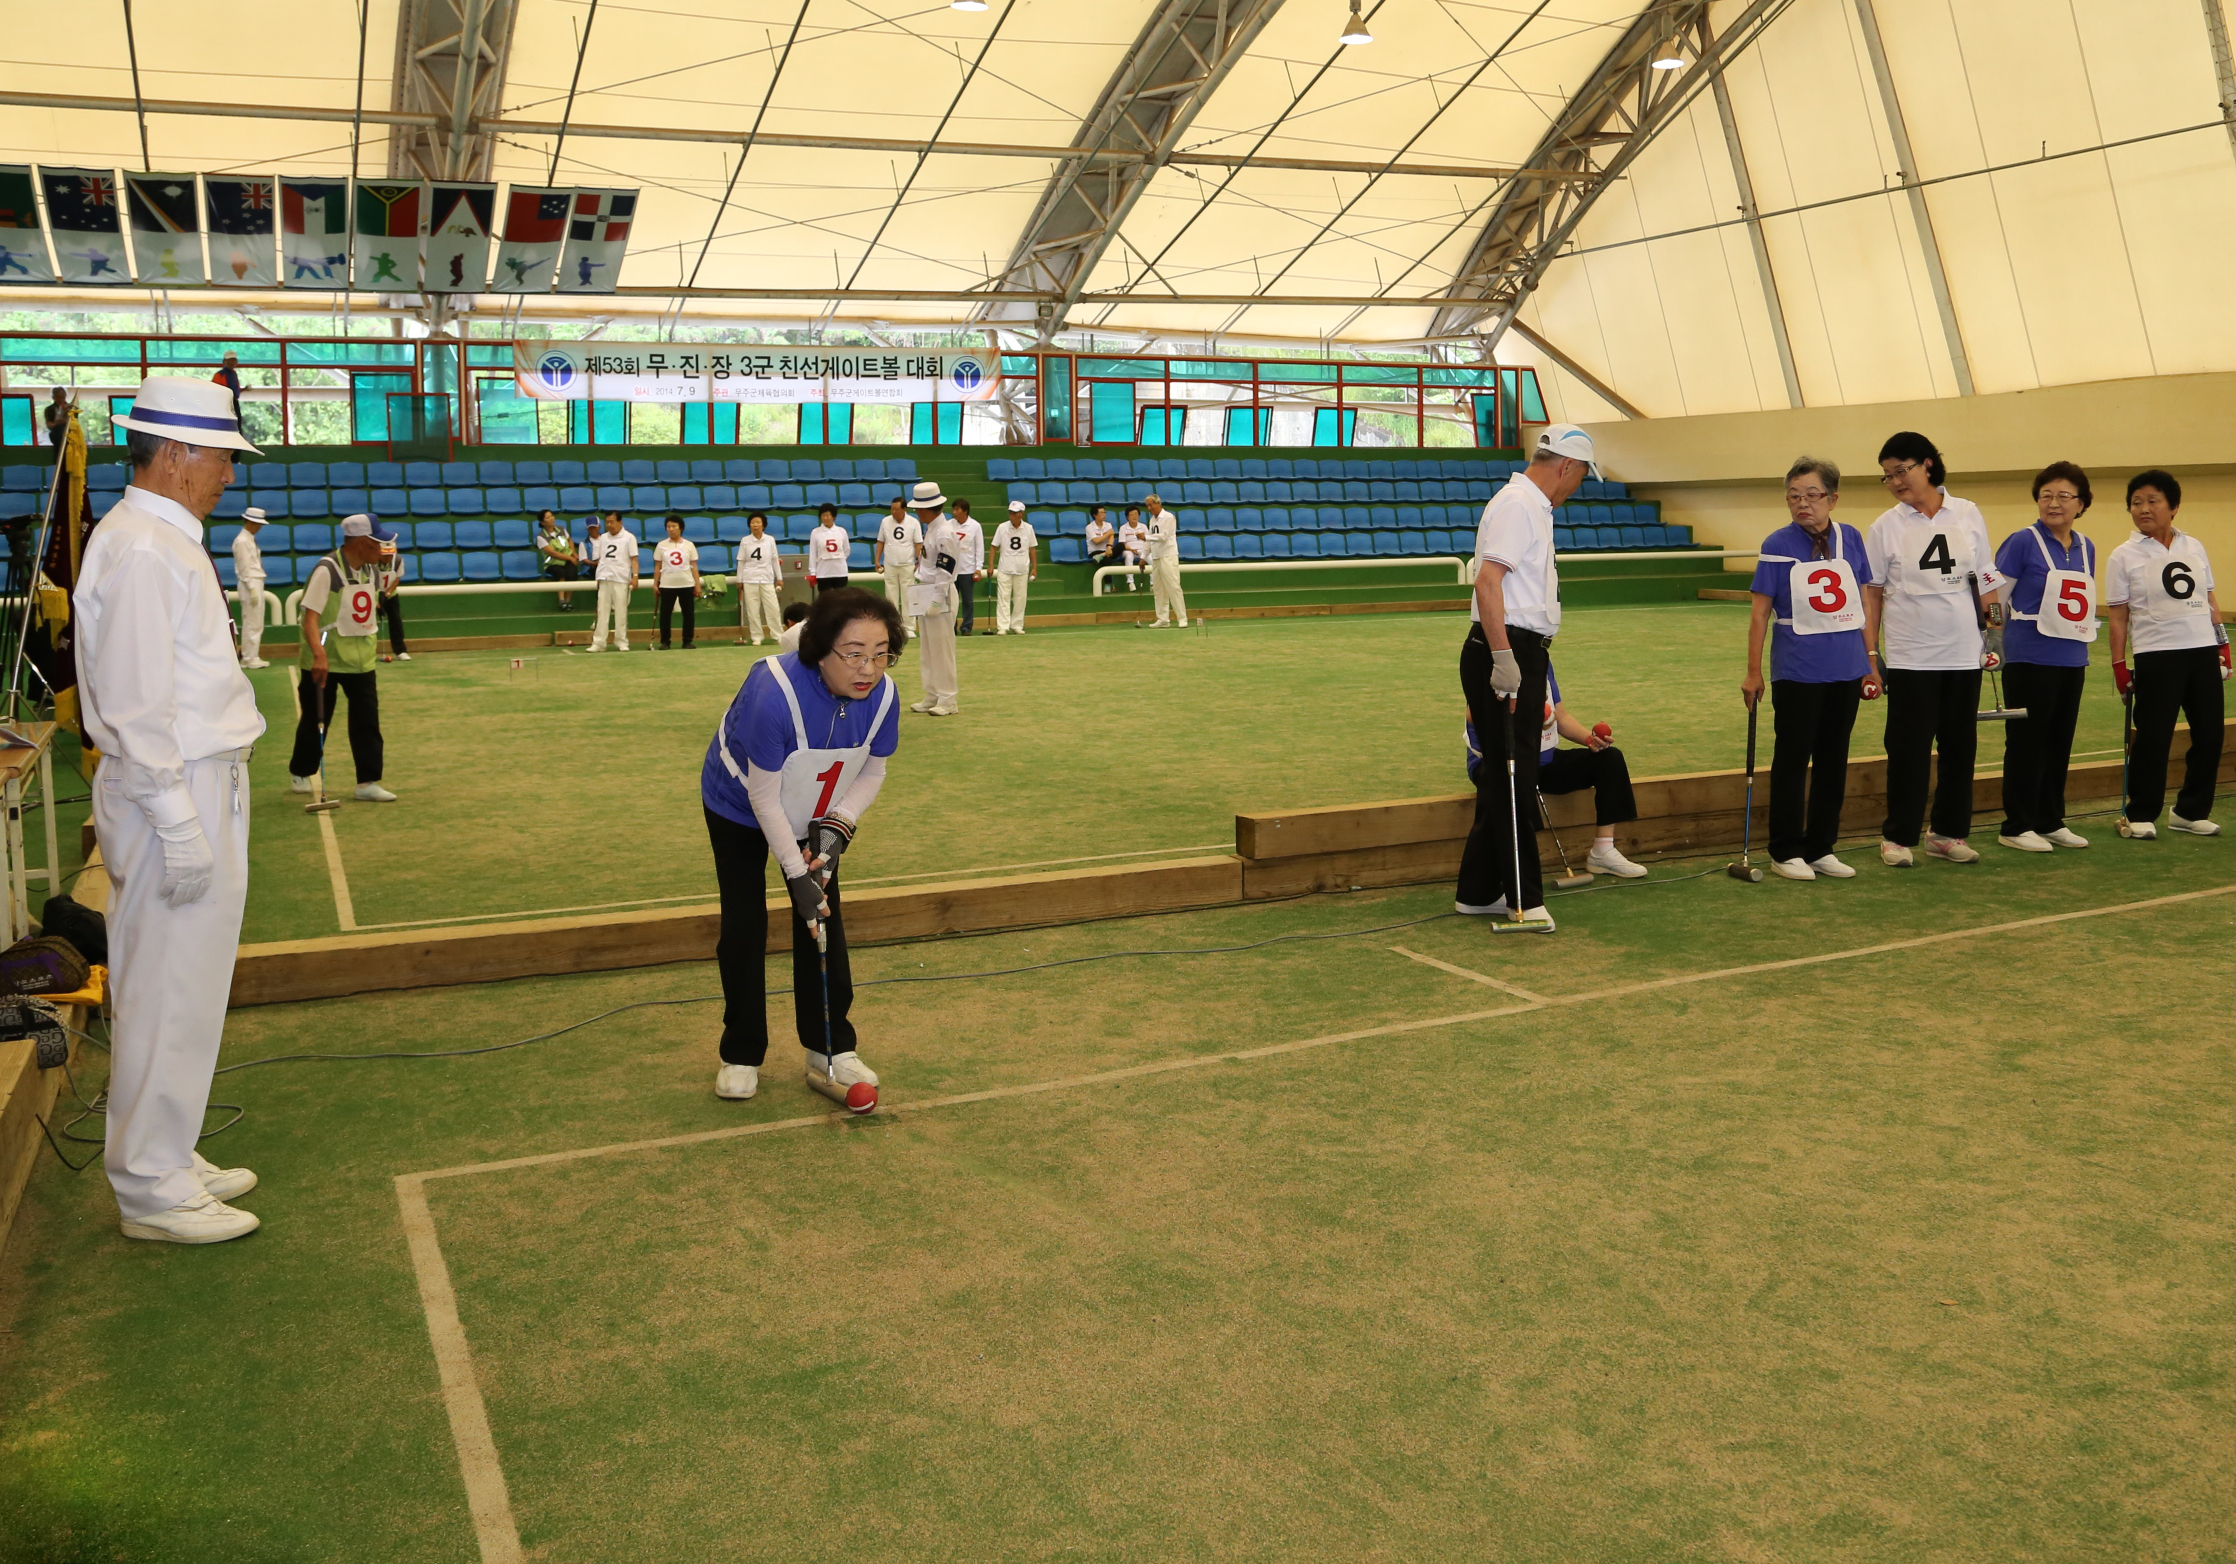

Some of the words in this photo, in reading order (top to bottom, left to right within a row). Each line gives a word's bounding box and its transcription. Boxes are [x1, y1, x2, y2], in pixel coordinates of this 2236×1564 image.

[584, 355, 640, 378] 제53회
[740, 355, 774, 380] 3군
[778, 355, 901, 381] 친선게이트볼
[906, 355, 944, 381] 대회
[633, 386, 650, 396] 일시
[688, 386, 696, 396] 9
[712, 387, 729, 398] 주관
[893, 526, 904, 540] 6
[825, 539, 838, 552] 5
[1010, 536, 1022, 551] 8
[605, 544, 618, 559] 2
[669, 551, 683, 566] 3
[750, 547, 762, 561] 4
[1918, 533, 1957, 575] 4
[382, 574, 389, 589] 1
[2161, 561, 2196, 600] 6
[1807, 568, 1847, 613] 3
[351, 590, 373, 624] 9
[2057, 578, 2089, 622] 5
[811, 760, 845, 819] 1
